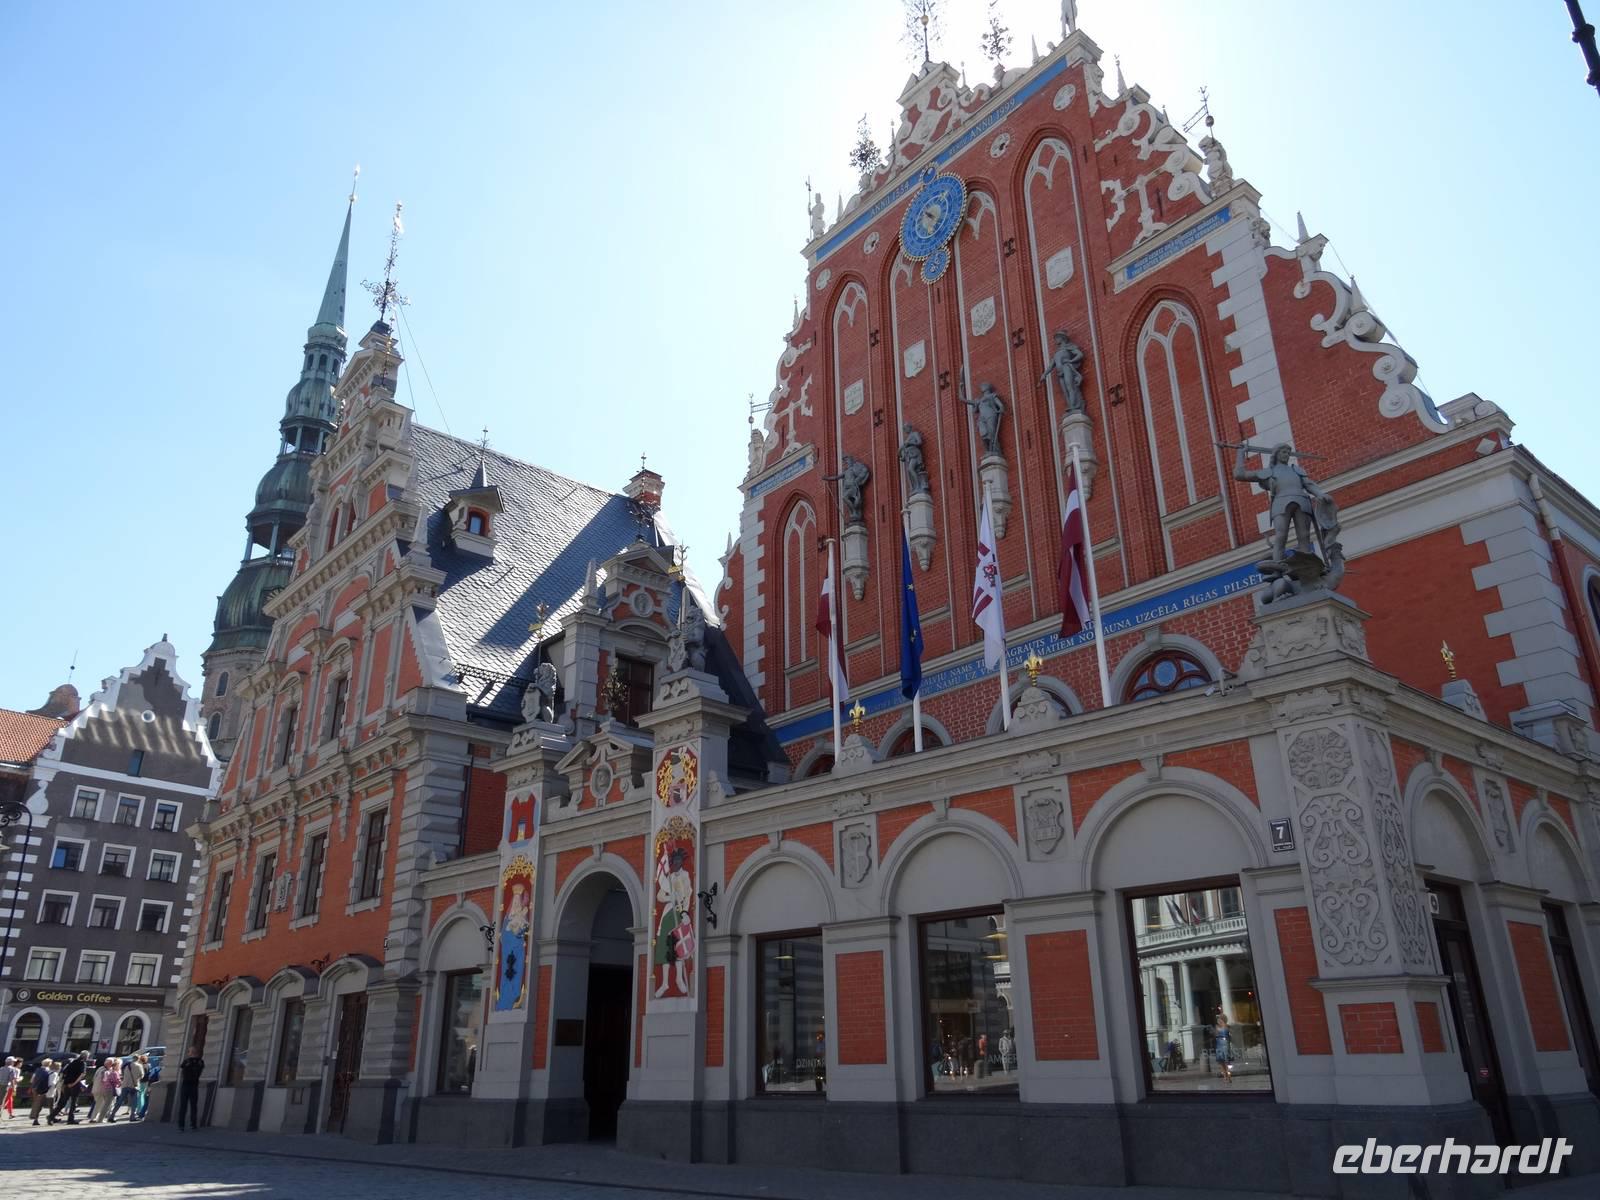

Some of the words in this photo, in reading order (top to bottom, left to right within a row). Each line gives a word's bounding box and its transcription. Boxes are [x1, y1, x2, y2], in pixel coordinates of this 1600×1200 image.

[1027, 637, 1074, 658] PMATIEM
[1078, 630, 1094, 644] NO
[1103, 618, 1132, 635] AUNA
[1006, 638, 1045, 658] AGRAUTS
[1276, 826, 1284, 840] 7
[36, 991, 73, 1001] Golden
[76, 992, 112, 1003] Coffee
